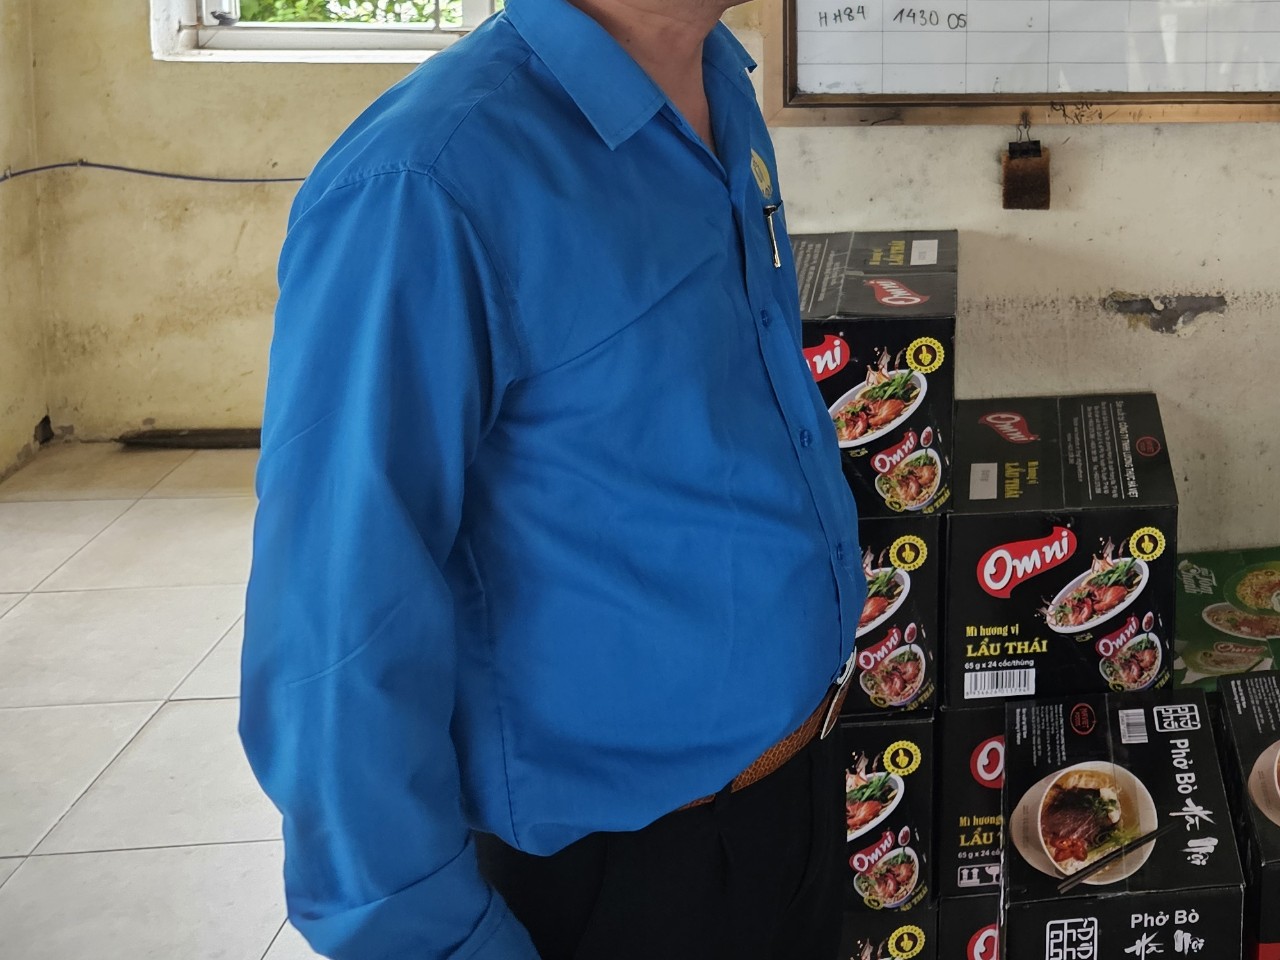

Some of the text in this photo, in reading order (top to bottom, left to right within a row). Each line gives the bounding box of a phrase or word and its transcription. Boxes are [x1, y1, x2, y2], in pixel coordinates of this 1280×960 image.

[984, 530, 1069, 590] Omni
[966, 638, 1048, 658] LẨU THÁI
[1169, 739, 1197, 794] Phở Bò
[1131, 908, 1200, 929] Phở Bò
